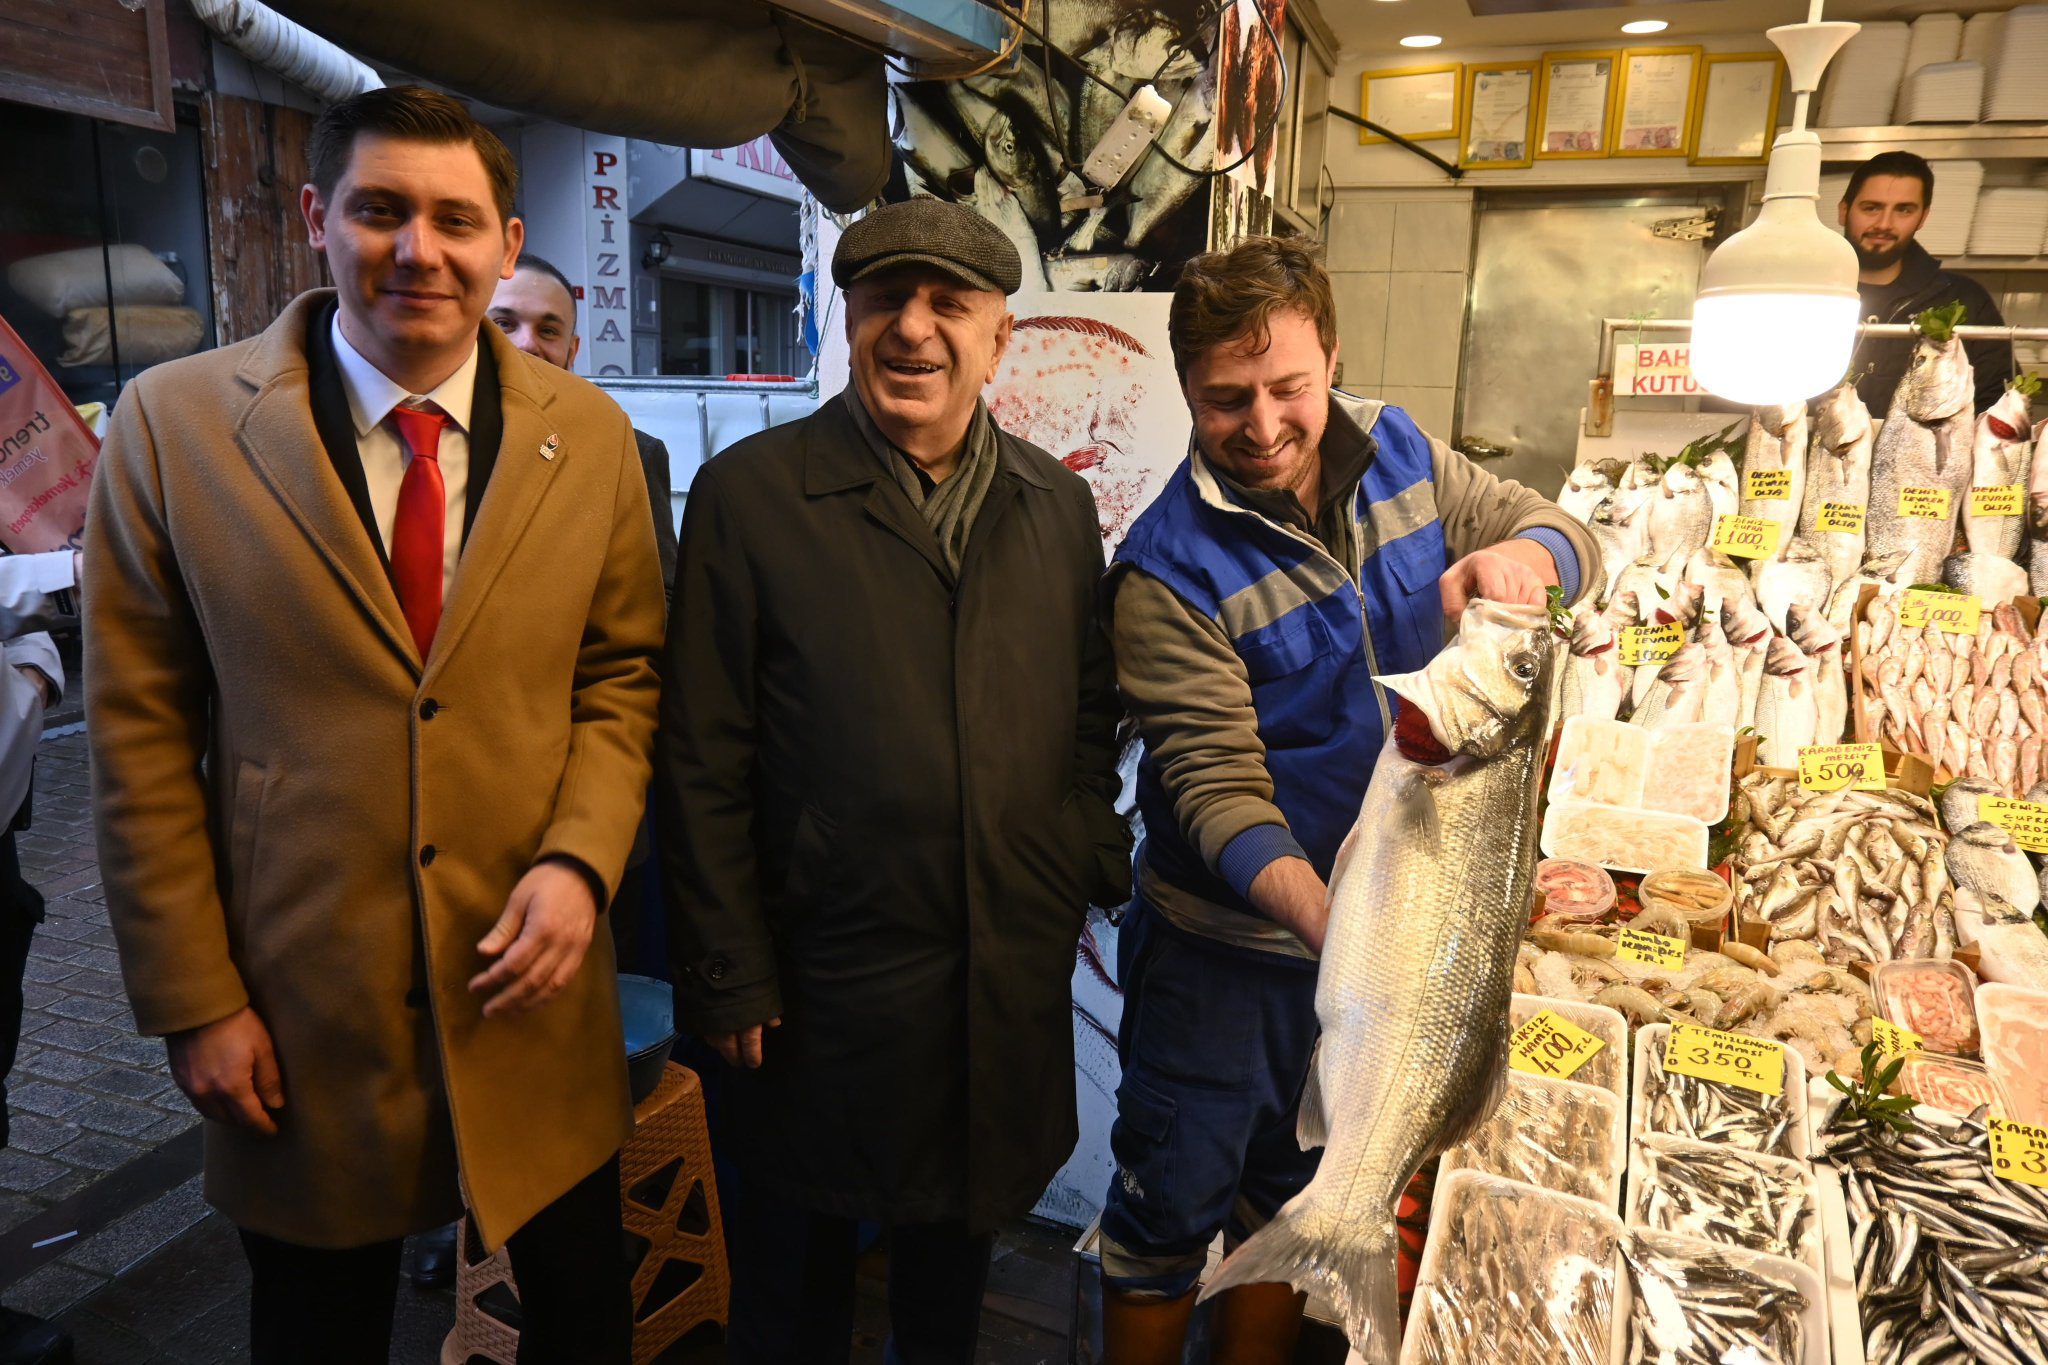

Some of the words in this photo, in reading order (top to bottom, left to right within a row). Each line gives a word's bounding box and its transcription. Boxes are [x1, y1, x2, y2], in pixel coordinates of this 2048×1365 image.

[593, 151, 626, 342] PRİZMA
[1639, 349, 1690, 368] BAH
[1754, 489, 1784, 497] OLTA
[1974, 494, 2017, 502] LEVREK
[1983, 503, 2012, 511] OLTA
[1828, 519, 1856, 528] OLTA
[1633, 624, 1673, 636] DENİZ
[1635, 634, 1680, 644] LEVREK
[1818, 762, 1864, 781] 500
[1988, 801, 2048, 813] DENİZ
[1509, 1015, 1549, 1053] ÇIKSIZ
[1531, 1032, 1573, 1074] 400
[1688, 1047, 1752, 1069] 350
